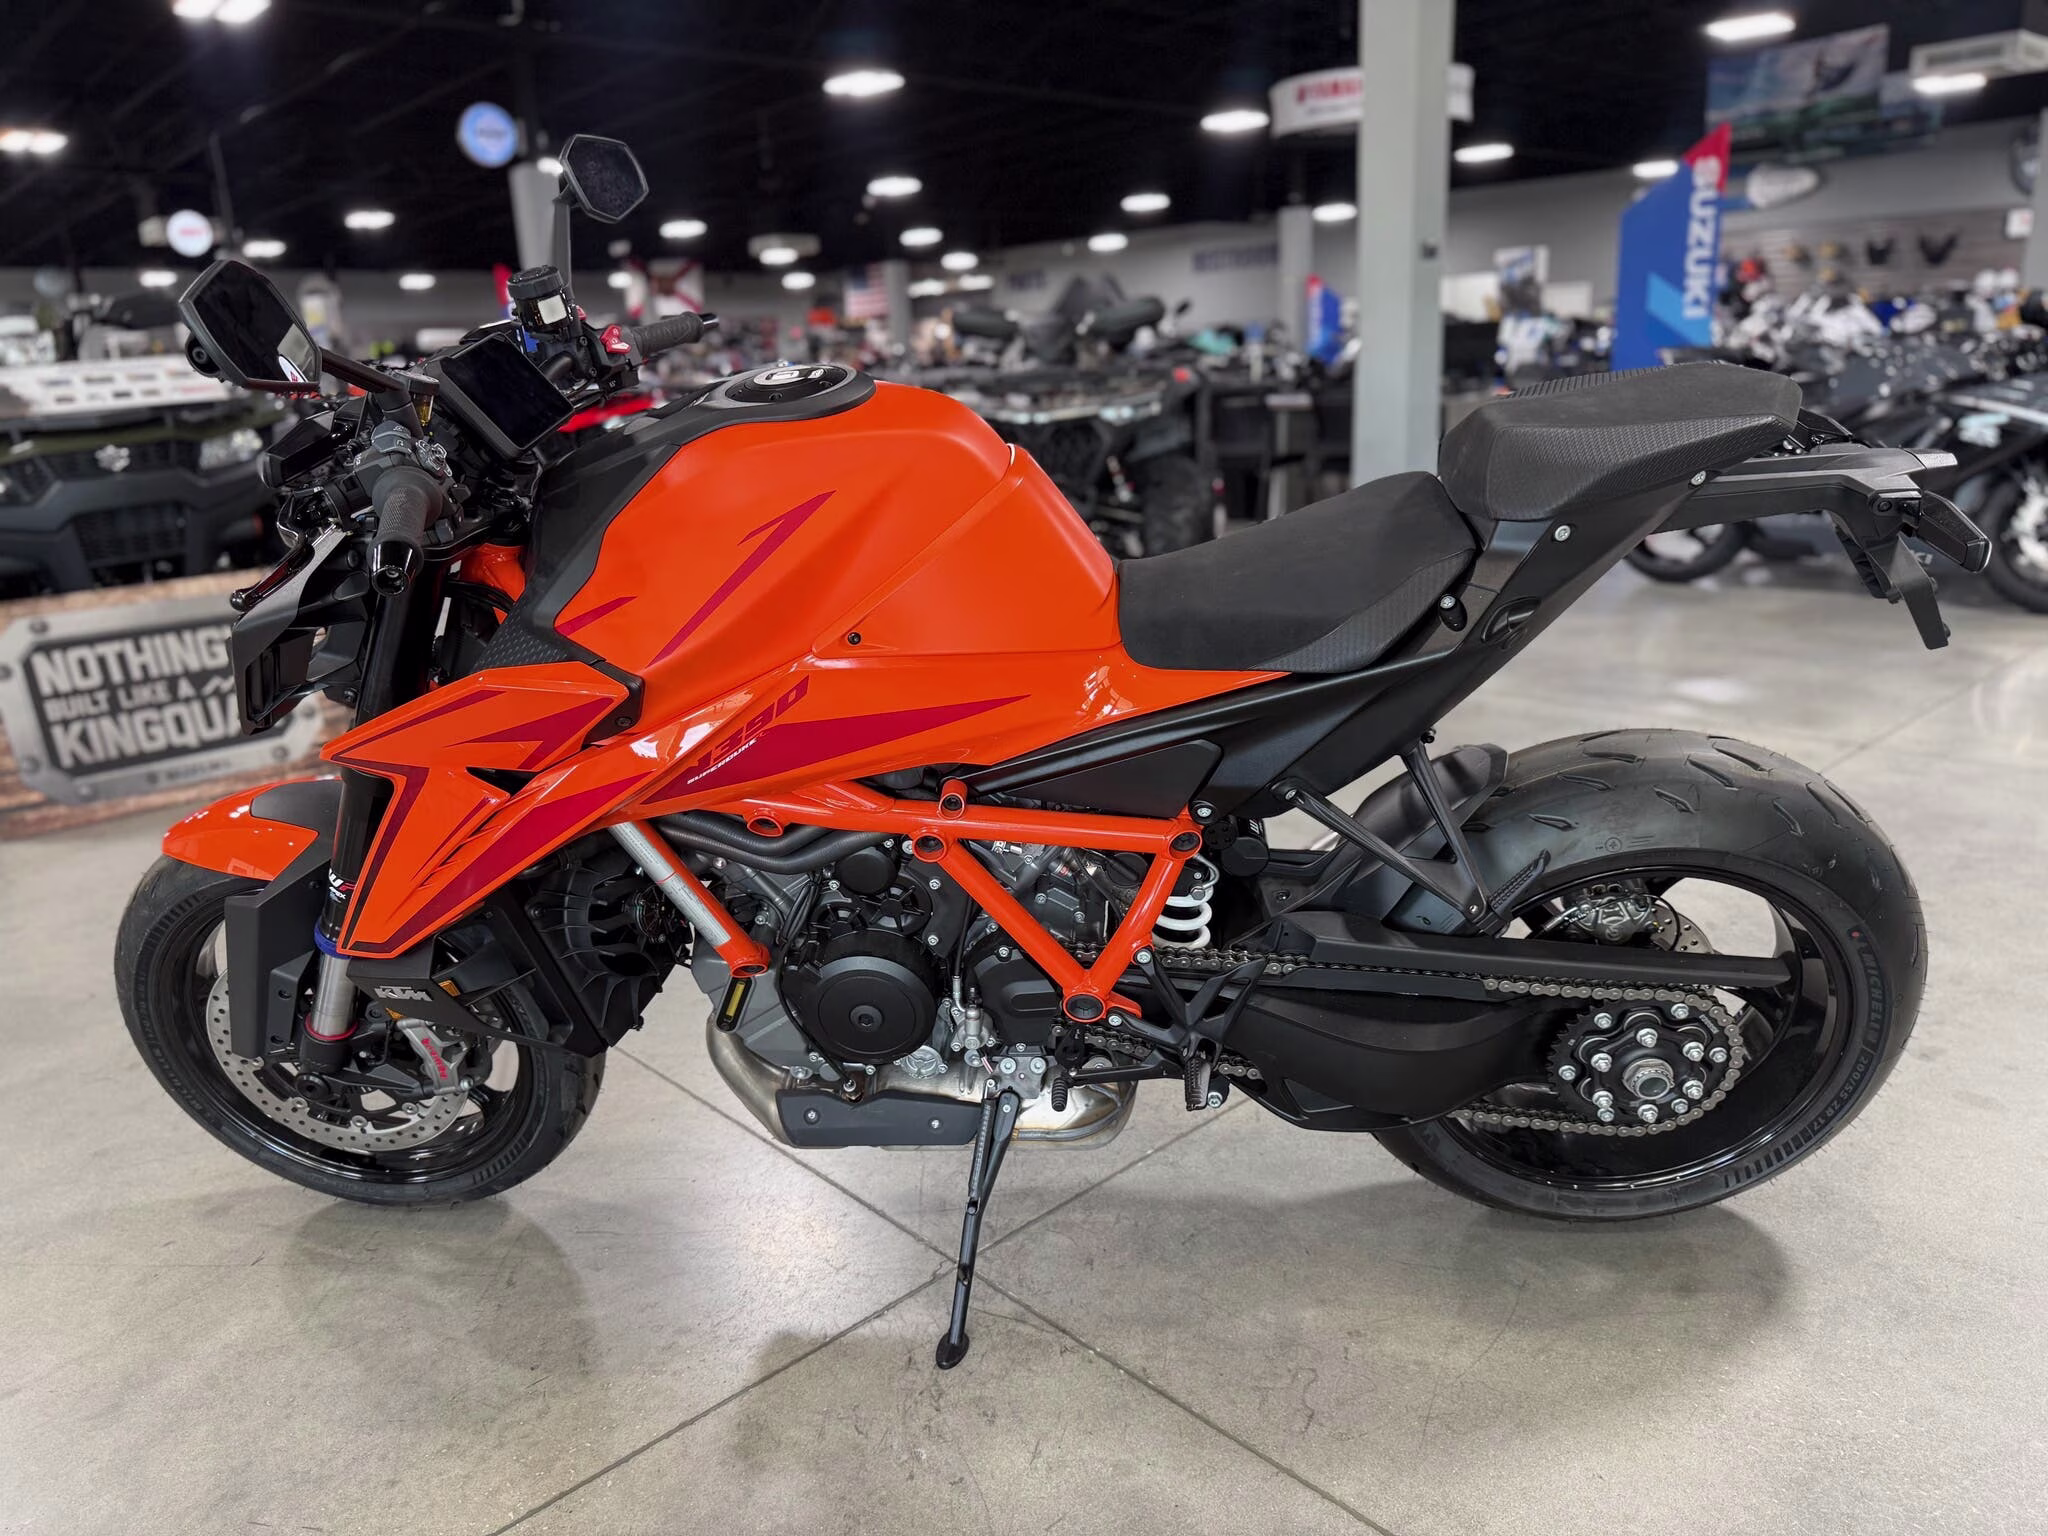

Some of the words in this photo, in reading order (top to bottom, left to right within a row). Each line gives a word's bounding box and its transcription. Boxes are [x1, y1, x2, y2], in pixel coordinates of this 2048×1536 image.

[1682, 155, 1722, 318] SUZUKI
[43, 690, 109, 722] BUILT
[117, 679, 172, 710] LIKE
[177, 675, 195, 700] A
[374, 985, 433, 1002] KTM
[1861, 952, 1884, 1043] MICHELIN
